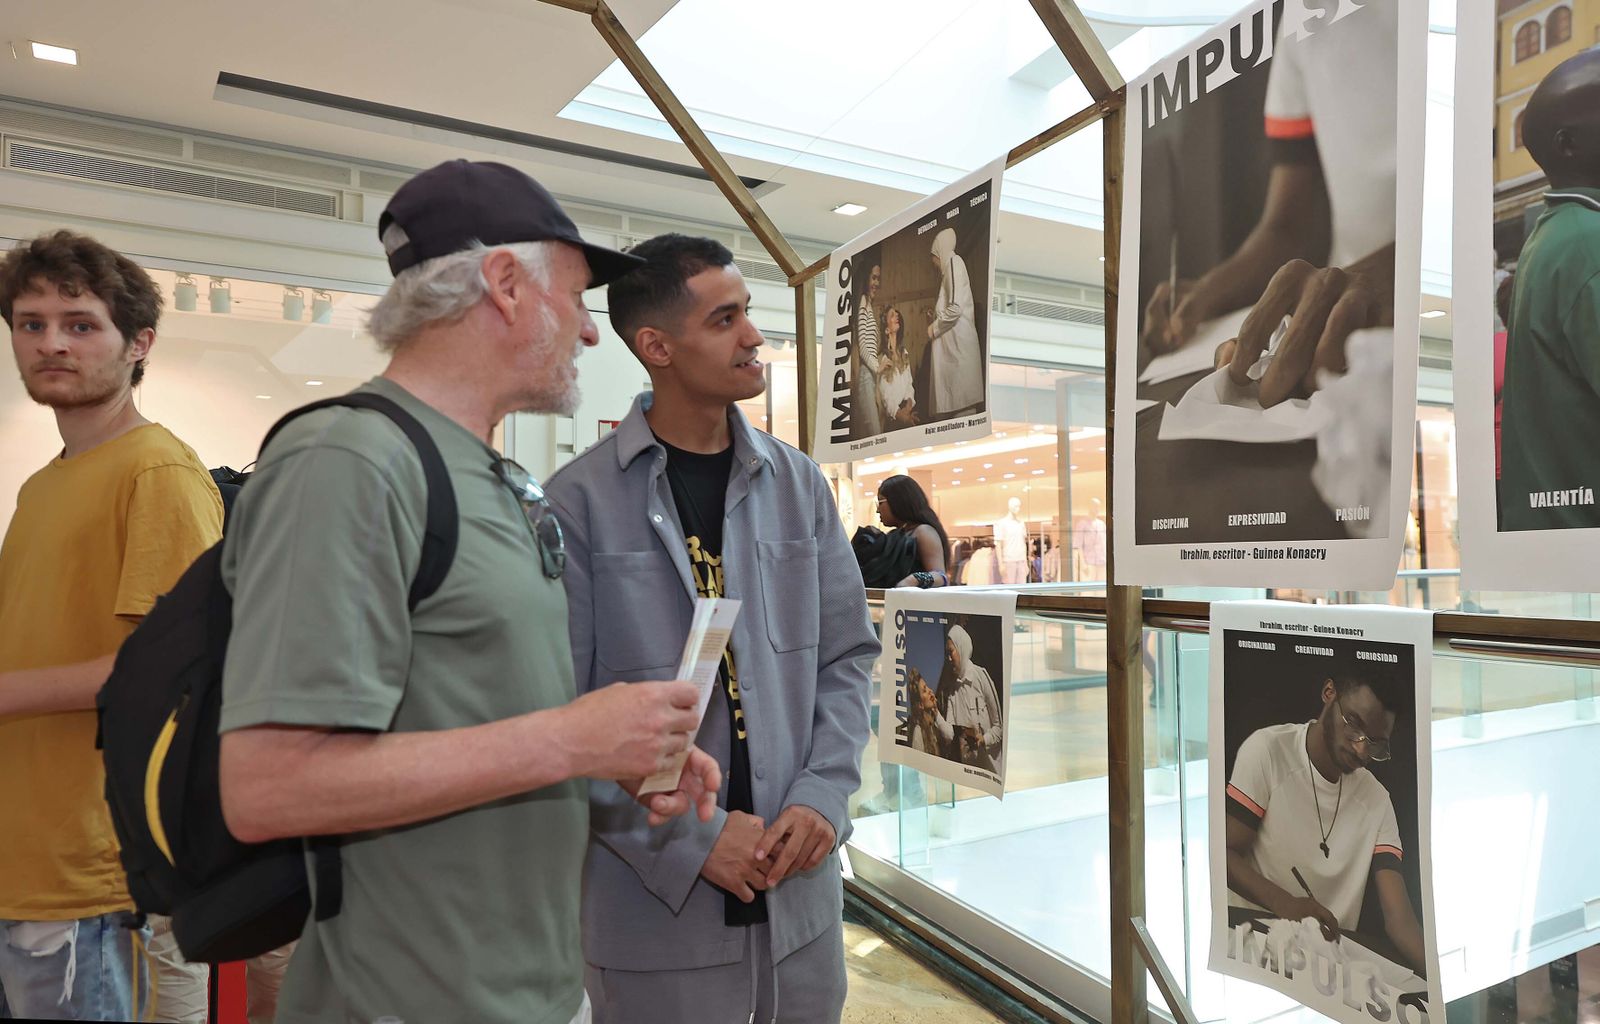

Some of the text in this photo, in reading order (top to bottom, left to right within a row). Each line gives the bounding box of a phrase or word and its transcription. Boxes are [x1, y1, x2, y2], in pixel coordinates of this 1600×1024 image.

[1141, 0, 1367, 128] IMPULS
[830, 258, 852, 444] IMPULSO
[1529, 486, 1595, 508] VALENTÍA
[1152, 504, 1370, 530] DISCIPLINA EXPRESIVIDAD PASIÓN
[1180, 548, 1212, 561] Ibrahim,
[1212, 548, 1245, 560] escritor
[1253, 547, 1284, 560] Guinea
[1286, 547, 1327, 561] Konacry
[1260, 621, 1284, 631] Ibrahim,
[1284, 622, 1309, 632] escritor
[1313, 625, 1336, 634] Guinea
[1336, 626, 1364, 637] Konacry
[1238, 639, 1398, 664] ORIGINALIDAD CREATIVIDAD CURIOSIDAD
[895, 609, 908, 747] IMPULSO
